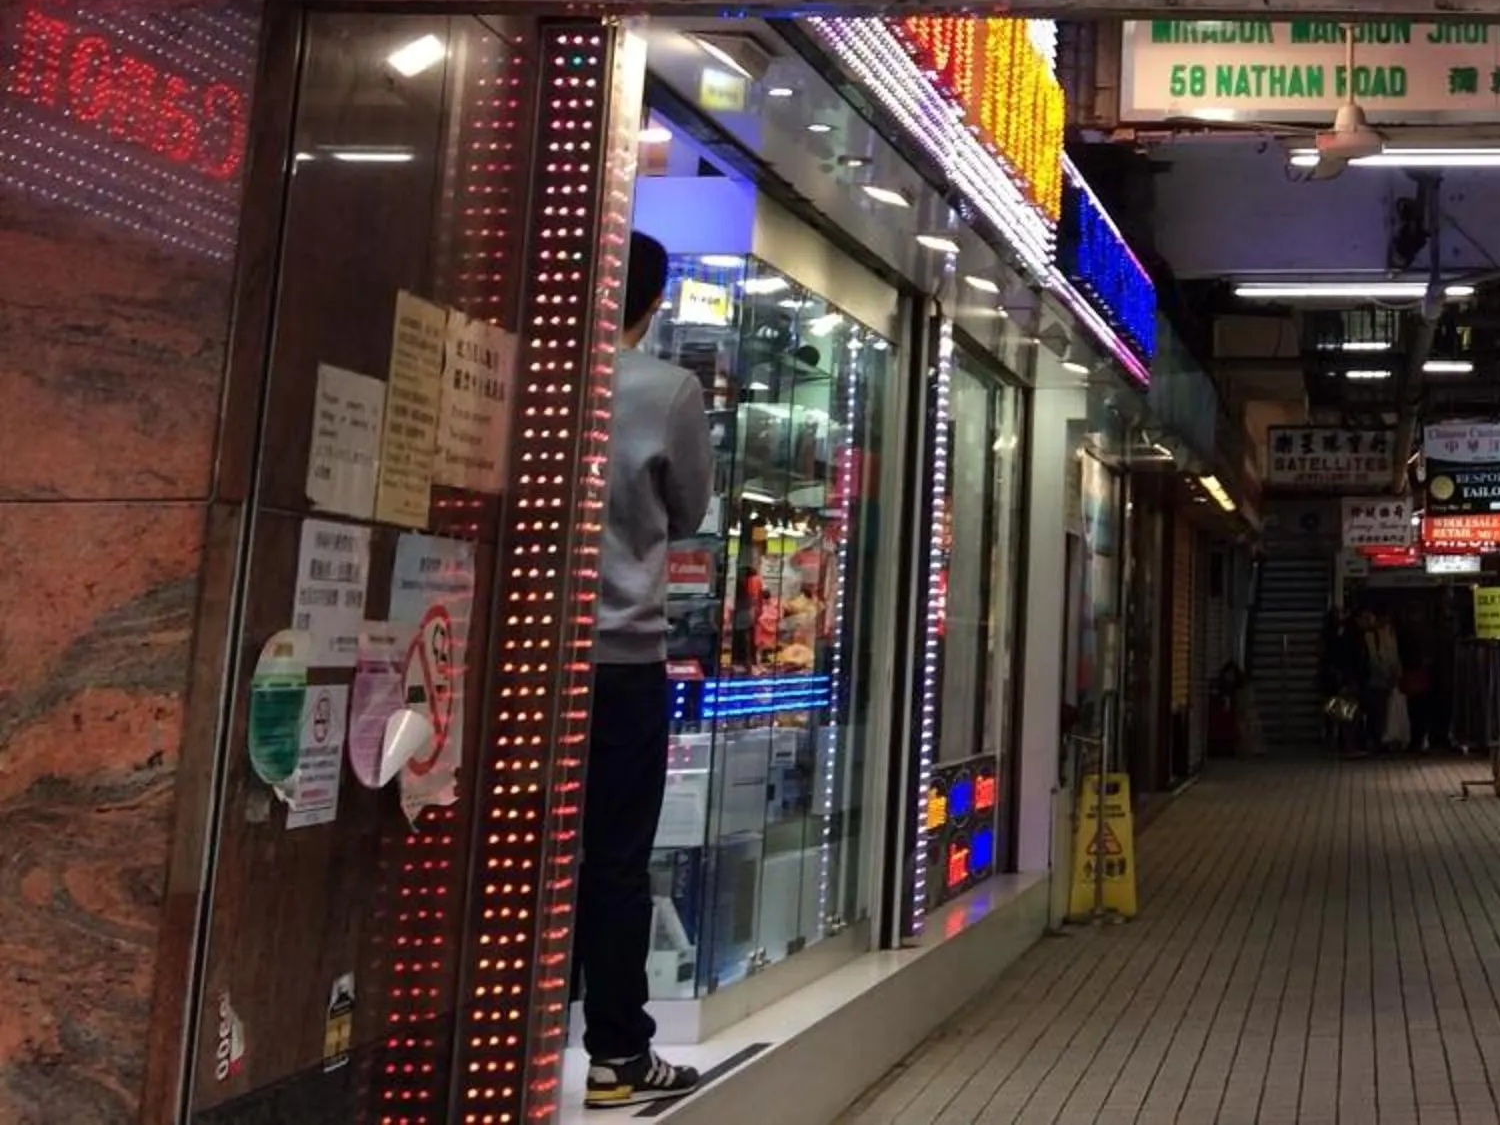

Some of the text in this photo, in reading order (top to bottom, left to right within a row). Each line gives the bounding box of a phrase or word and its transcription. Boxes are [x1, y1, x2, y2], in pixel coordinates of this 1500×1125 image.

[1169, 64, 1207, 97] 58
[1215, 64, 1325, 98] NATHAN
[1274, 456, 1388, 472] SATELLITES
